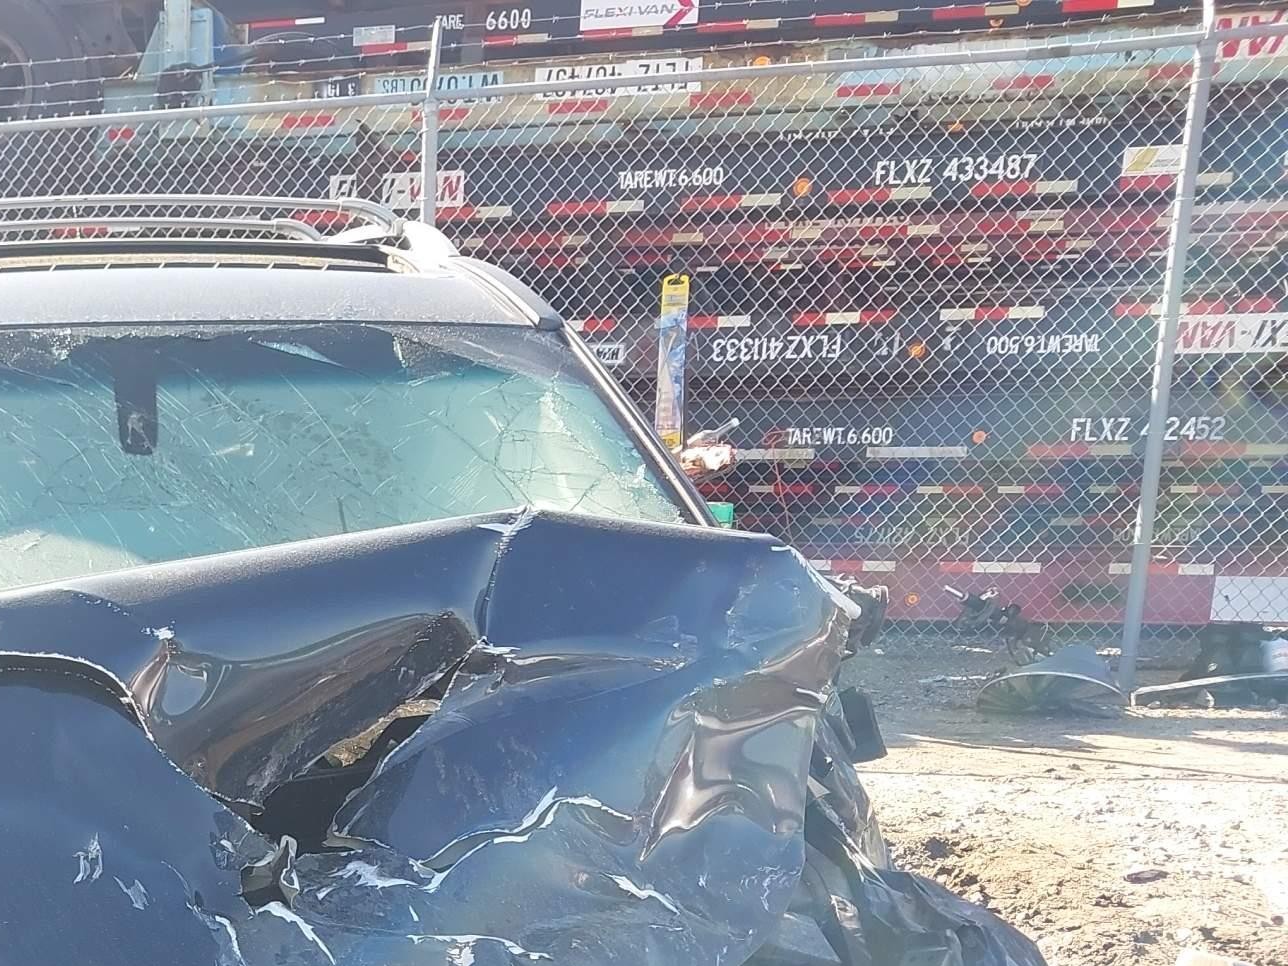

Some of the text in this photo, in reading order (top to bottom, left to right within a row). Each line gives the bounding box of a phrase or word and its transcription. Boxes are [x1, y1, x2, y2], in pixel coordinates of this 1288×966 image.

[485, 8, 532, 31] 6600
[875, 153, 1039, 186] FLXZ 433487
[785, 334, 842, 359] FLXZ
[1070, 416, 1131, 442] FLXZ
